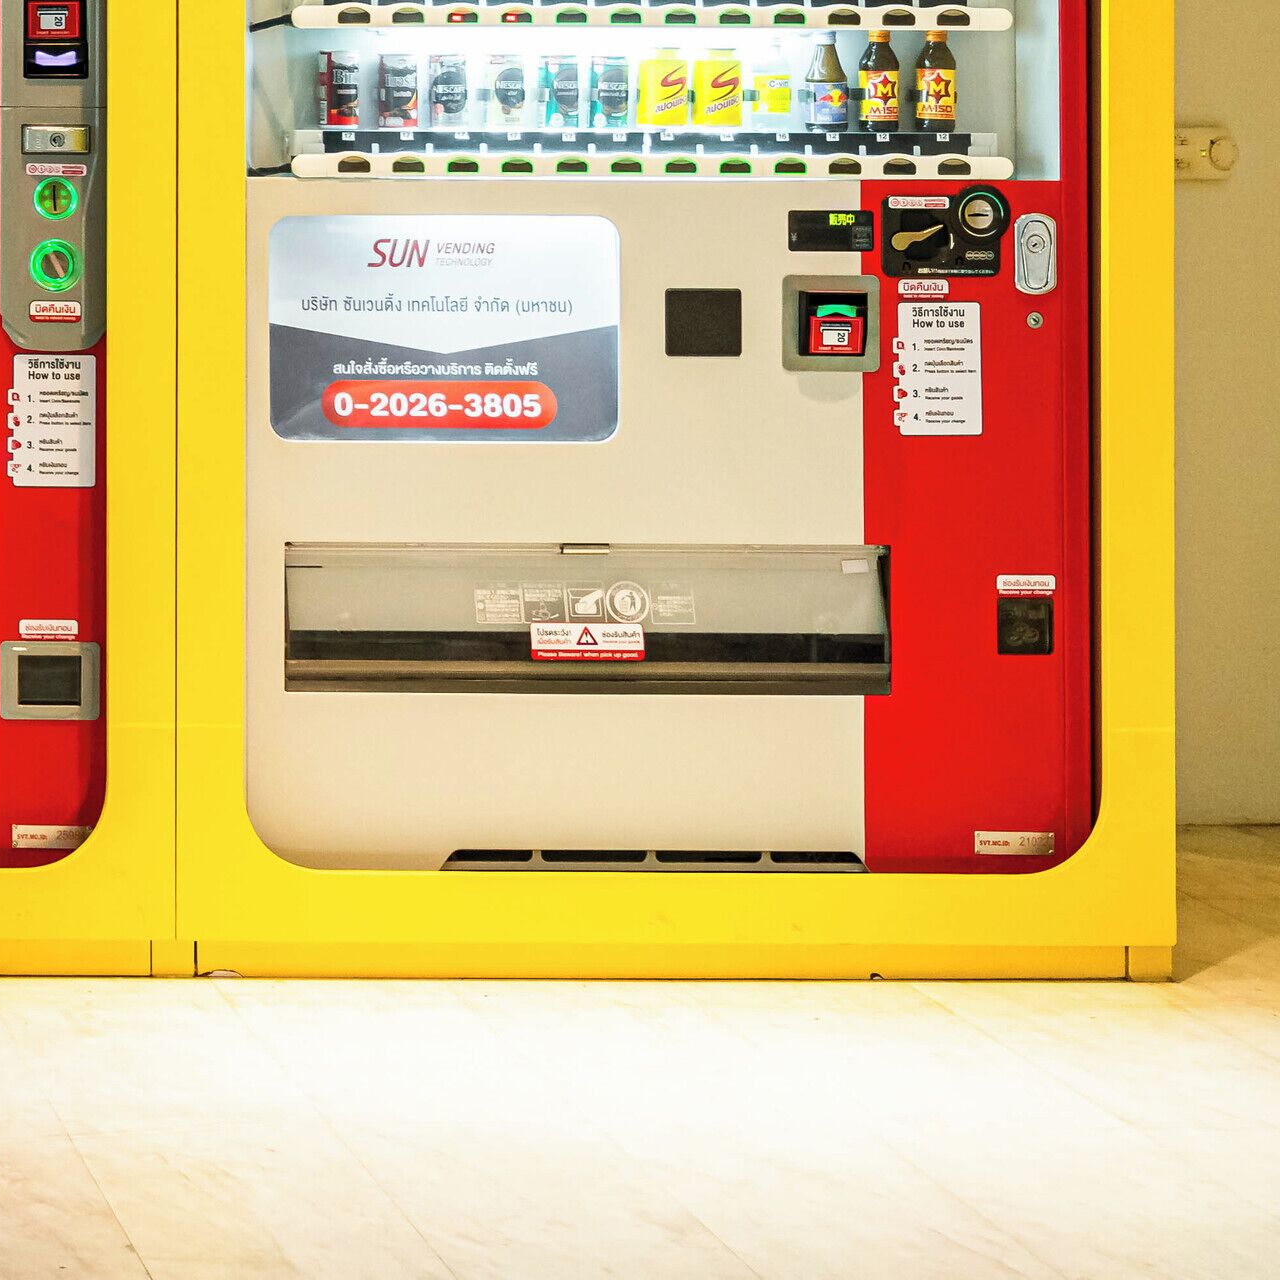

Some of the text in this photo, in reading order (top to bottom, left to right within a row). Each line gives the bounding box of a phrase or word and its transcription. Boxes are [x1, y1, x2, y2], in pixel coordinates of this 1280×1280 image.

[55, 17, 62, 26] 20
[877, 84, 892, 97] M
[930, 84, 947, 97] M
[870, 106, 898, 114] M-150
[922, 105, 952, 113] M-150
[367, 238, 495, 268] SUN VENDING
[435, 257, 492, 267] TECHNOLOGY
[903, 282, 944, 292] บิดคืนเงิน
[35, 304, 76, 314] บิดคืนเงิน
[301, 293, 573, 317] บริษัท ซันเวนดิ้ง เทคโนโลยี จำกัด (มหาชน)
[912, 306, 965, 317] วิธีการใช้งาน
[912, 319, 965, 328] How to use
[837, 332, 845, 343] 20
[912, 343, 920, 351] 1.
[28, 358, 80, 369] วิธีการใช้งาน
[484, 359, 539, 377] ติดตั้งฟรี
[912, 364, 920, 372] 2.
[28, 371, 80, 380] How to use
[913, 390, 921, 398] 3.
[333, 392, 542, 419] 0-2026-3805
[27, 416, 34, 424] 2.
[913, 413, 921, 421] 4.
[27, 441, 34, 449] 3.
[27, 464, 34, 472] 4.
